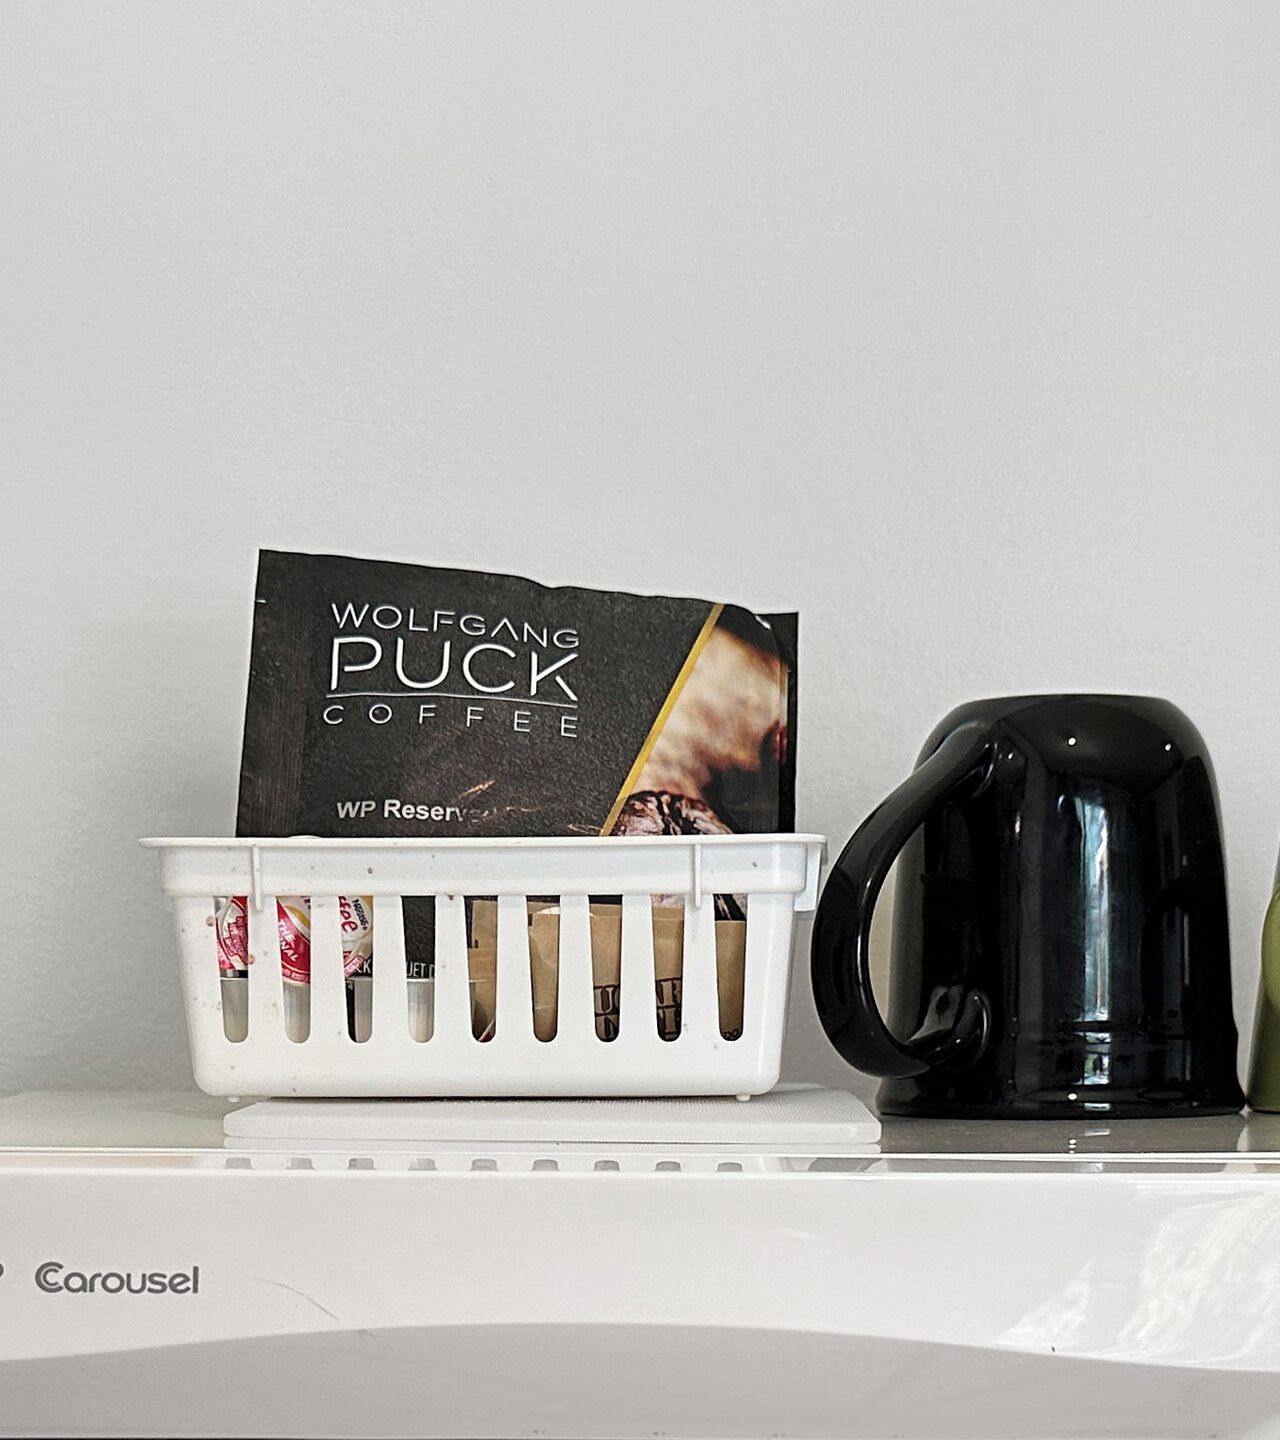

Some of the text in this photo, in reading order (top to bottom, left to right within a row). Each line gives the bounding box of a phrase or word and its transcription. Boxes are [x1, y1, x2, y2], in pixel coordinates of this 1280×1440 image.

[331, 602, 580, 649] WOLFGANG
[330, 636, 579, 701] PUCK
[323, 704, 578, 737] COFFEE
[336, 801, 376, 819] WP
[278, 920, 295, 943] THE
[35, 1261, 199, 1294] Carousel
